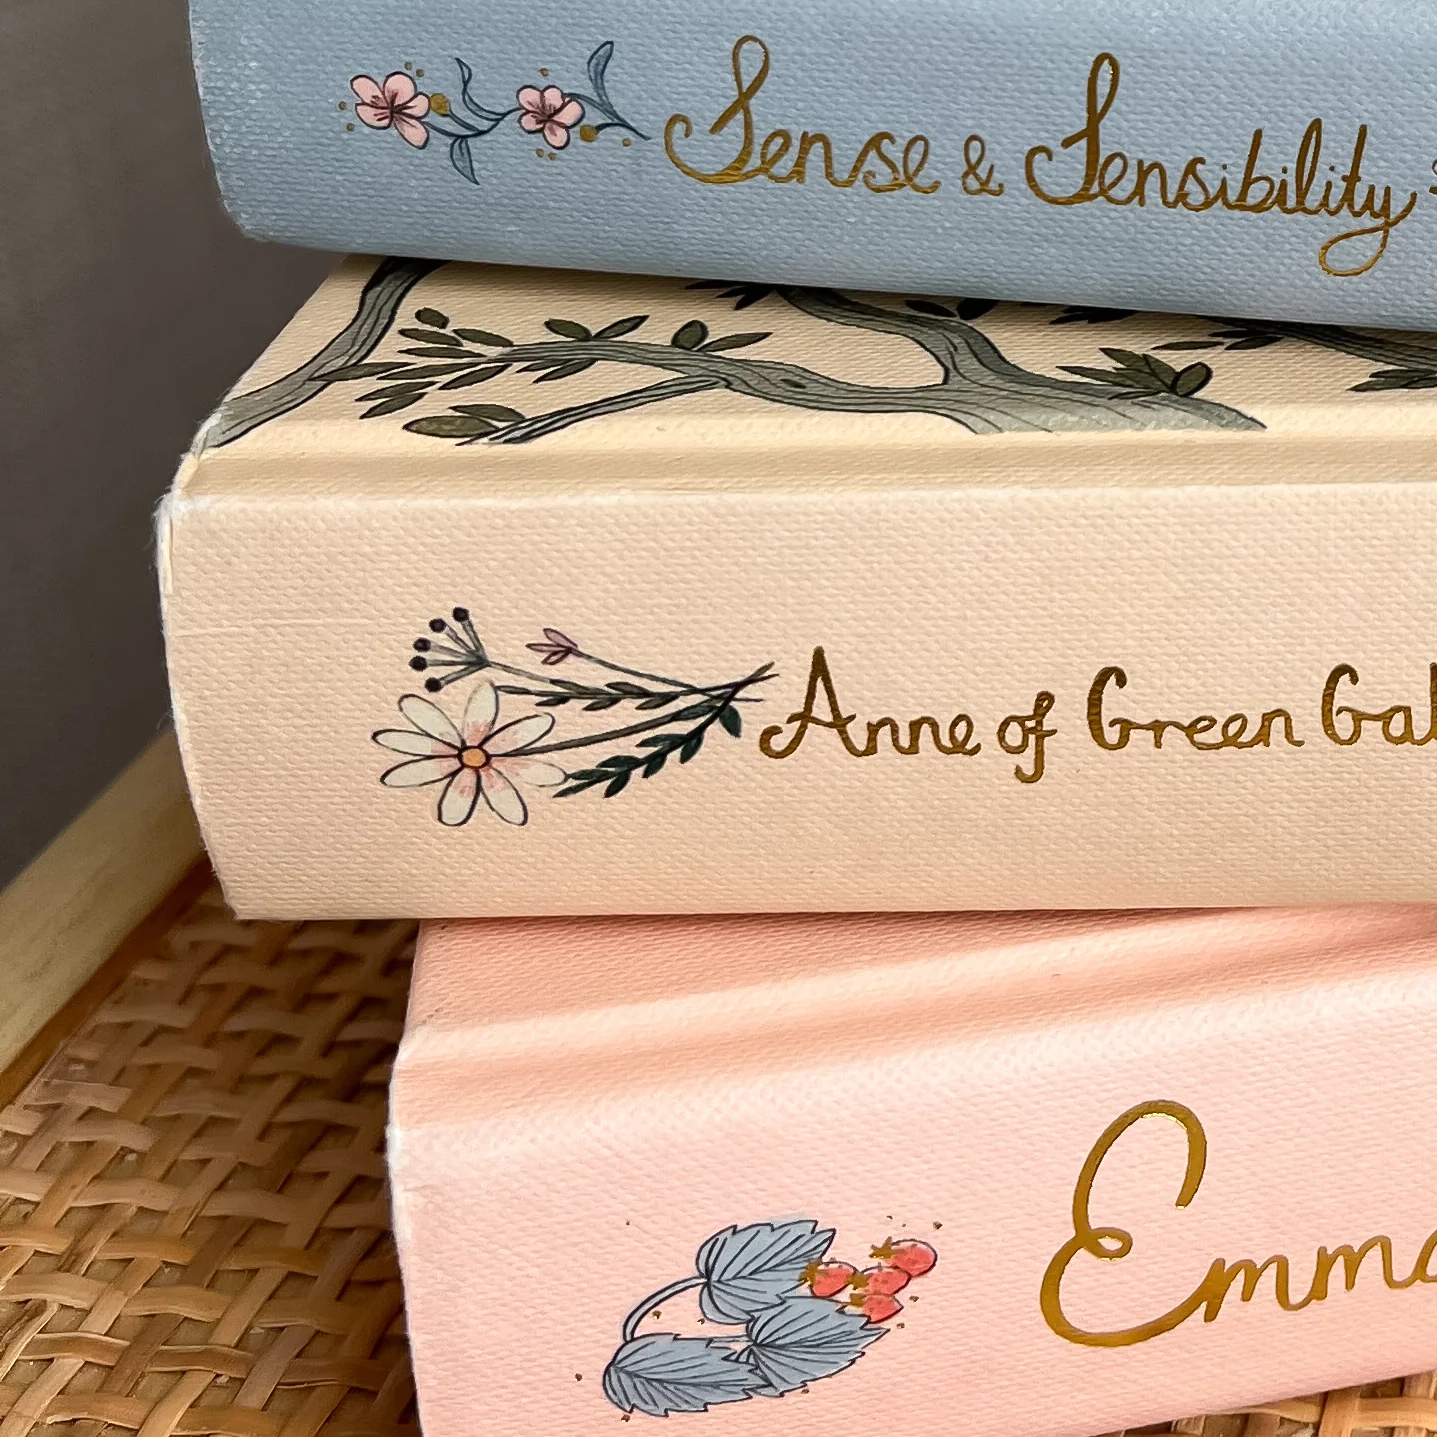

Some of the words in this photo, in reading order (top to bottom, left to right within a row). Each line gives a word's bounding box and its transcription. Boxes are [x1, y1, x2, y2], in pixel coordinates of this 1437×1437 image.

[664, 35, 940, 194] Sense
[961, 135, 1004, 195] &
[1025, 52, 1417, 277] Sensibility
[758, 645, 982, 759] Anne
[996, 690, 1058, 784] of
[1086, 666, 1304, 750] Green
